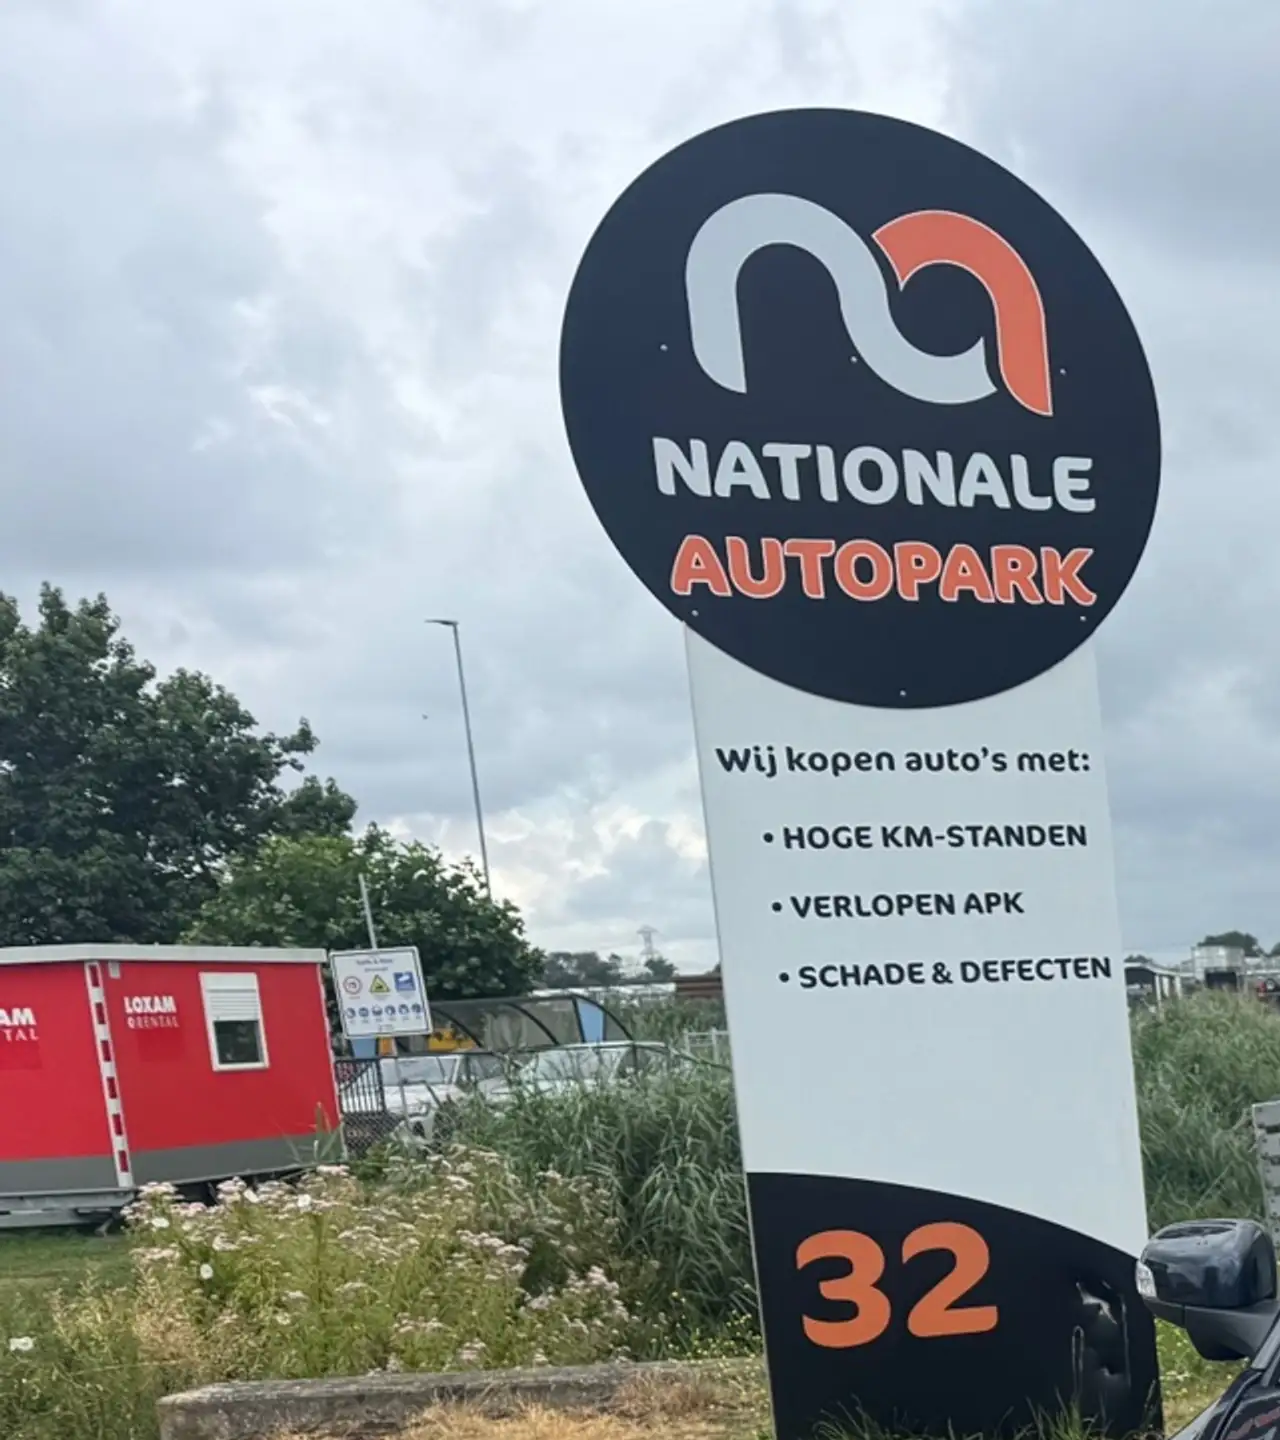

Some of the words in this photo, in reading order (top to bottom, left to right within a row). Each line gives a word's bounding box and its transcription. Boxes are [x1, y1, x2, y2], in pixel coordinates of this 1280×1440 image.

[652, 436, 1097, 513] NATIONALE
[670, 534, 1097, 607] AUTOPARK
[715, 746, 777, 778] Wij
[786, 746, 896, 777] kopen
[904, 747, 1008, 772] auto's
[1017, 748, 1091, 772] met:
[782, 826, 873, 849] HOGE
[881, 824, 1088, 848] KM-STANDEN
[790, 893, 956, 918] VERLOPEN
[963, 891, 1025, 915] APK
[798, 961, 926, 989] SCHADE
[931, 961, 953, 985] &
[960, 956, 1112, 984] DEFECTEN
[123, 995, 177, 1013] LOXAM
[795, 1220, 999, 1349] 32
